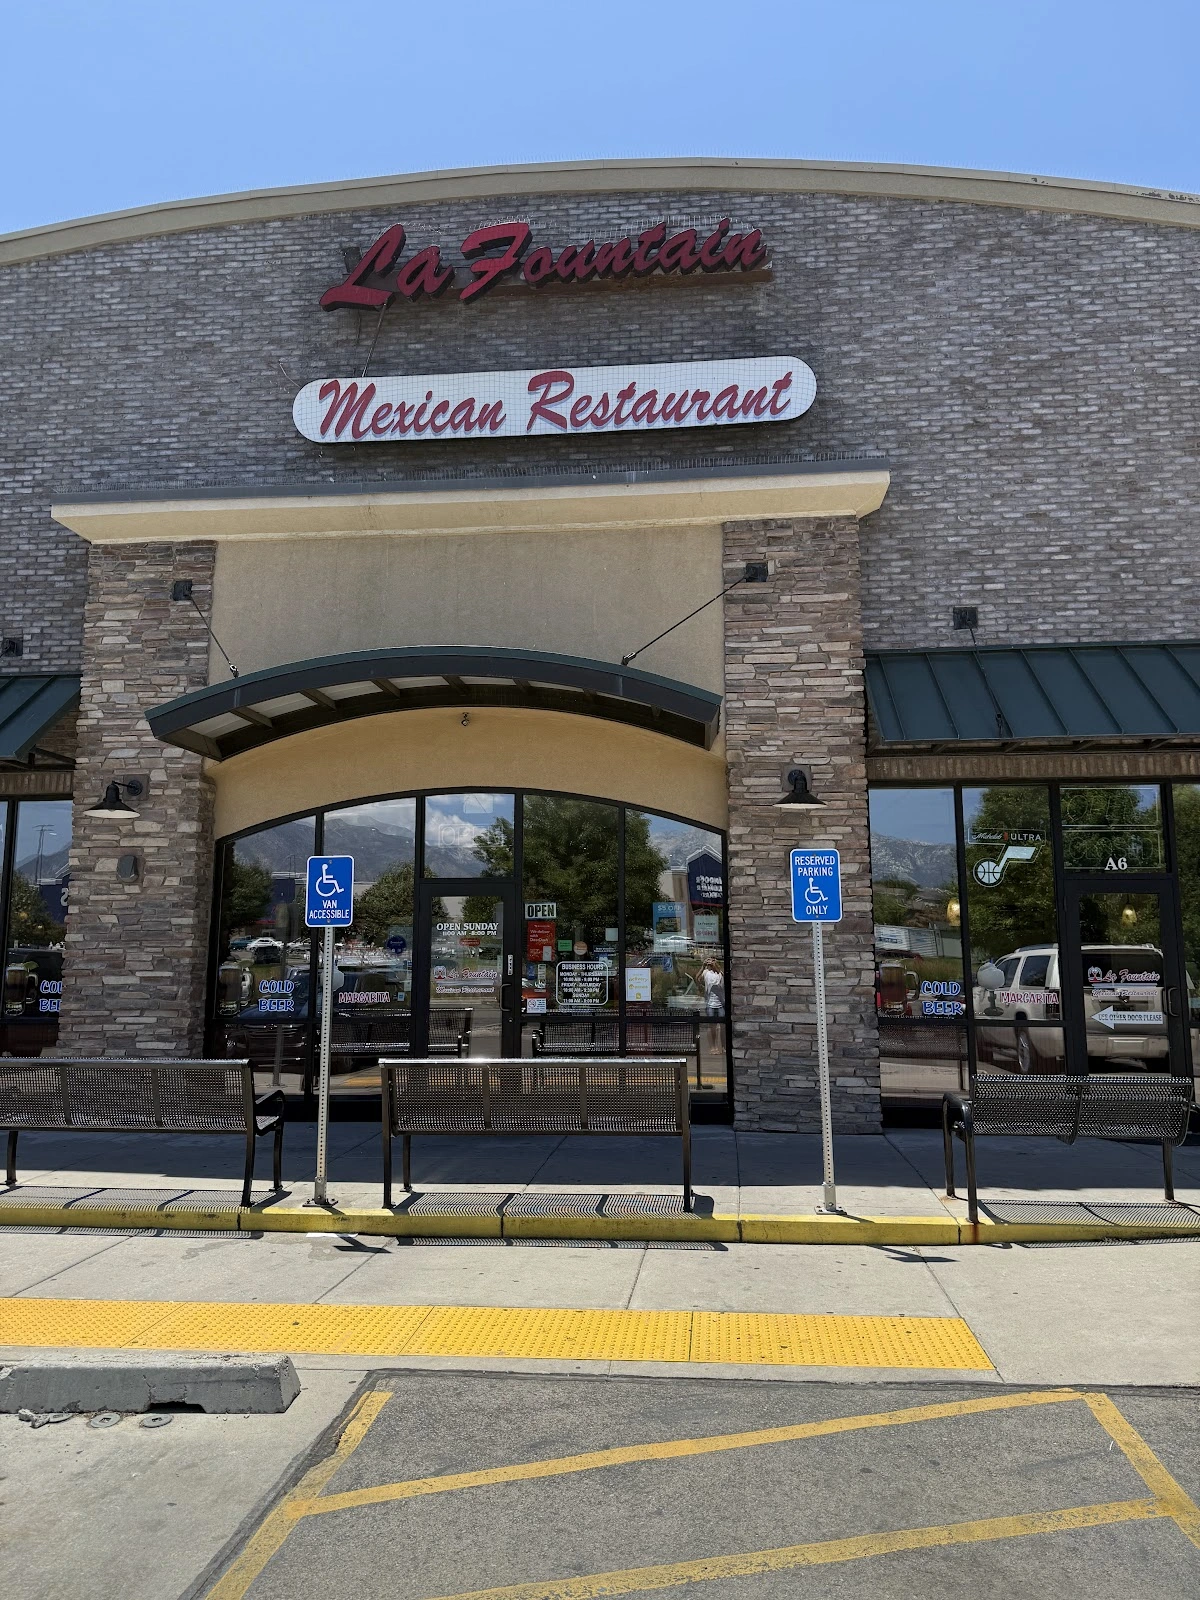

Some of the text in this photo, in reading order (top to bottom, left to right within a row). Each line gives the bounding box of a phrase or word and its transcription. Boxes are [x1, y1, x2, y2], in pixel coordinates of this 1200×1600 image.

[319, 216, 767, 311] La Fountain
[317, 370, 794, 442] Mexican Restaurant
[1010, 832, 1042, 841] ULTRA
[795, 856, 835, 866] RESERVED
[1104, 857, 1128, 871] A6
[798, 867, 833, 877] PARKING
[322, 900, 338, 909] VAN
[527, 904, 555, 918] OPEN
[806, 905, 828, 915] ONLY
[309, 909, 350, 919] ACCESSIBLE
[436, 922, 499, 931] OPEN SUNDAY
[461, 967, 498, 980] Fountain
[1102, 968, 1161, 984] La Fountain
[259, 979, 295, 994] COLD
[921, 980, 961, 996] COLD
[338, 992, 391, 1004] MARGARITA
[1000, 991, 1060, 1005] MARGARITA
[258, 998, 295, 1012] BEER
[922, 1001, 963, 1016] BEER
[1109, 1012, 1127, 1021] OTHER
